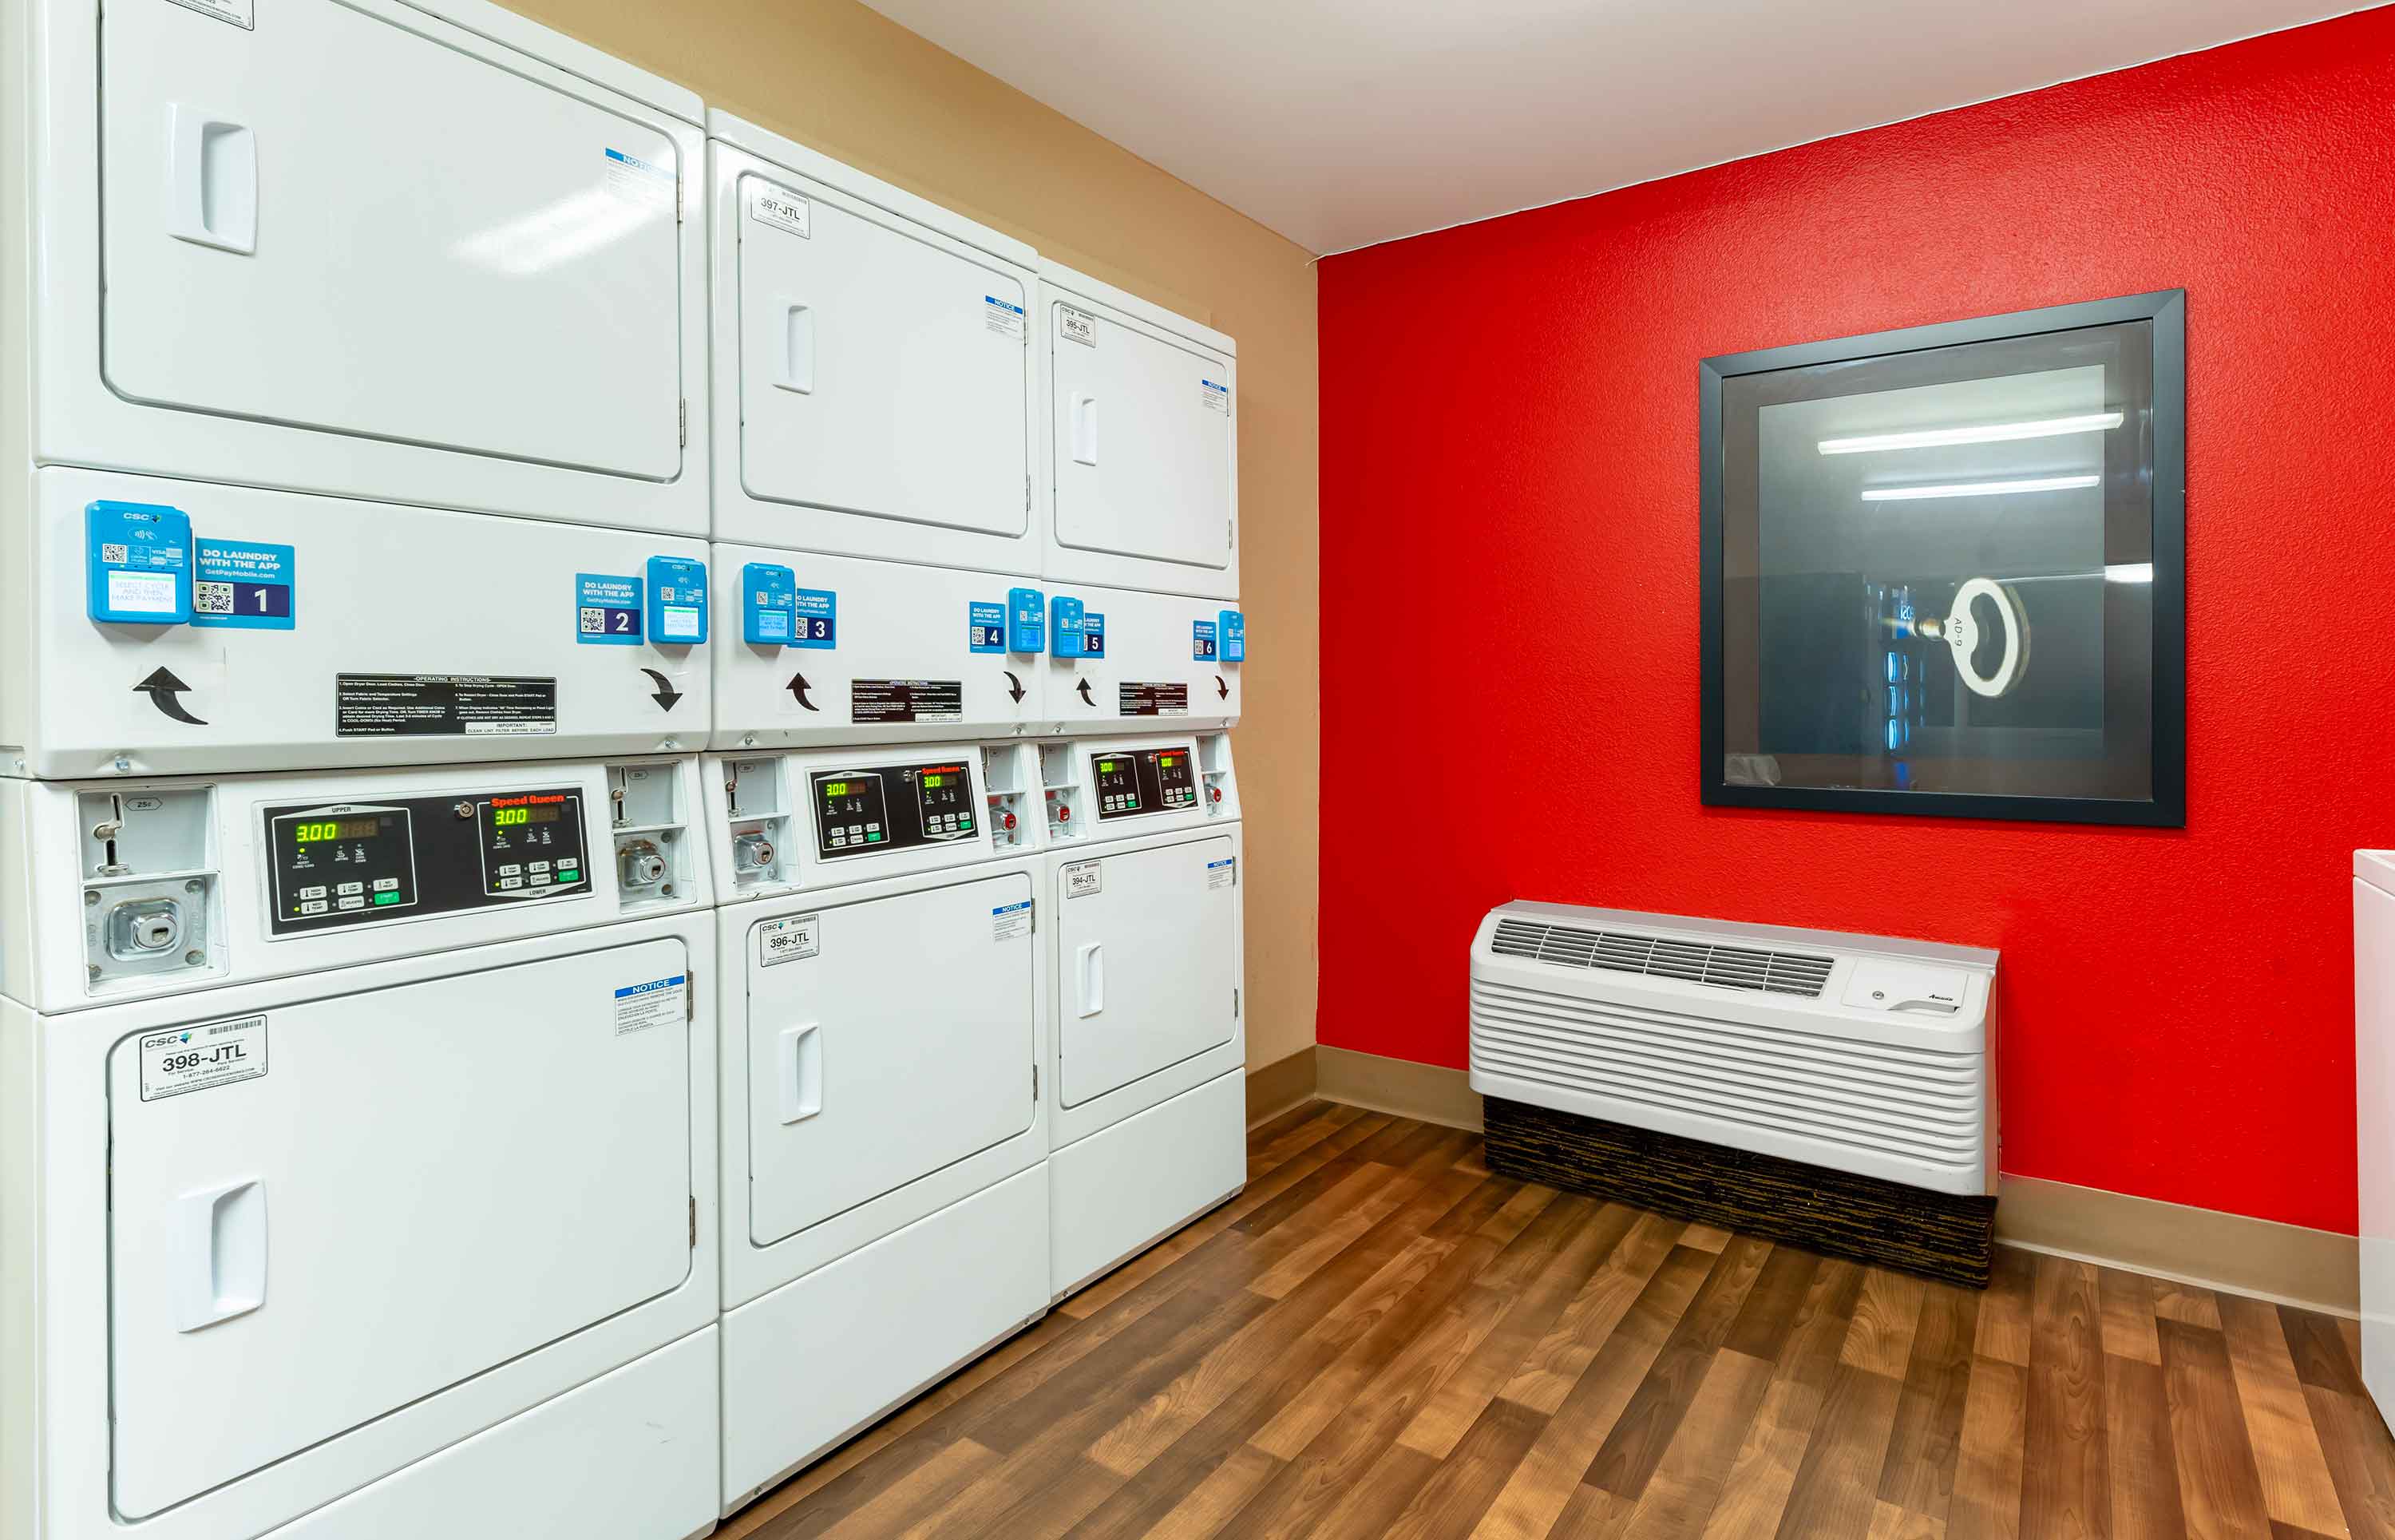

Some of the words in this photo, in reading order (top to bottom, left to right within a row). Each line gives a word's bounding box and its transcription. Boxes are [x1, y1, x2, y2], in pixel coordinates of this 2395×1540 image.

[761, 198, 800, 220] 397-JTL
[995, 300, 1015, 311] NOTICE
[1066, 319, 1090, 334] 395-JTL
[202, 549, 220, 558] DO
[223, 550, 278, 561] LAUNDRY
[200, 558, 231, 568] WITH
[233, 560, 255, 569] THE
[258, 560, 281, 571] APP
[204, 568, 275, 579] GetPayMobile.com
[254, 588, 267, 612] 1
[616, 612, 628, 631] 2
[815, 621, 825, 638] 3
[990, 630, 999, 643] 4
[1091, 637, 1098, 649] 5
[1206, 642, 1212, 654] 6
[491, 796, 527, 807] Speed
[529, 794, 564, 804] Queen
[495, 809, 527, 825] 3.00
[297, 824, 336, 842] 3.00
[1073, 875, 1095, 885] 394-JTL
[1002, 904, 1023, 913] NOTICE
[770, 932, 810, 948] 396-JTL
[632, 980, 670, 994] NOTICE
[145, 1035, 178, 1048] CSC
[162, 1044, 247, 1072] 398-JTL
